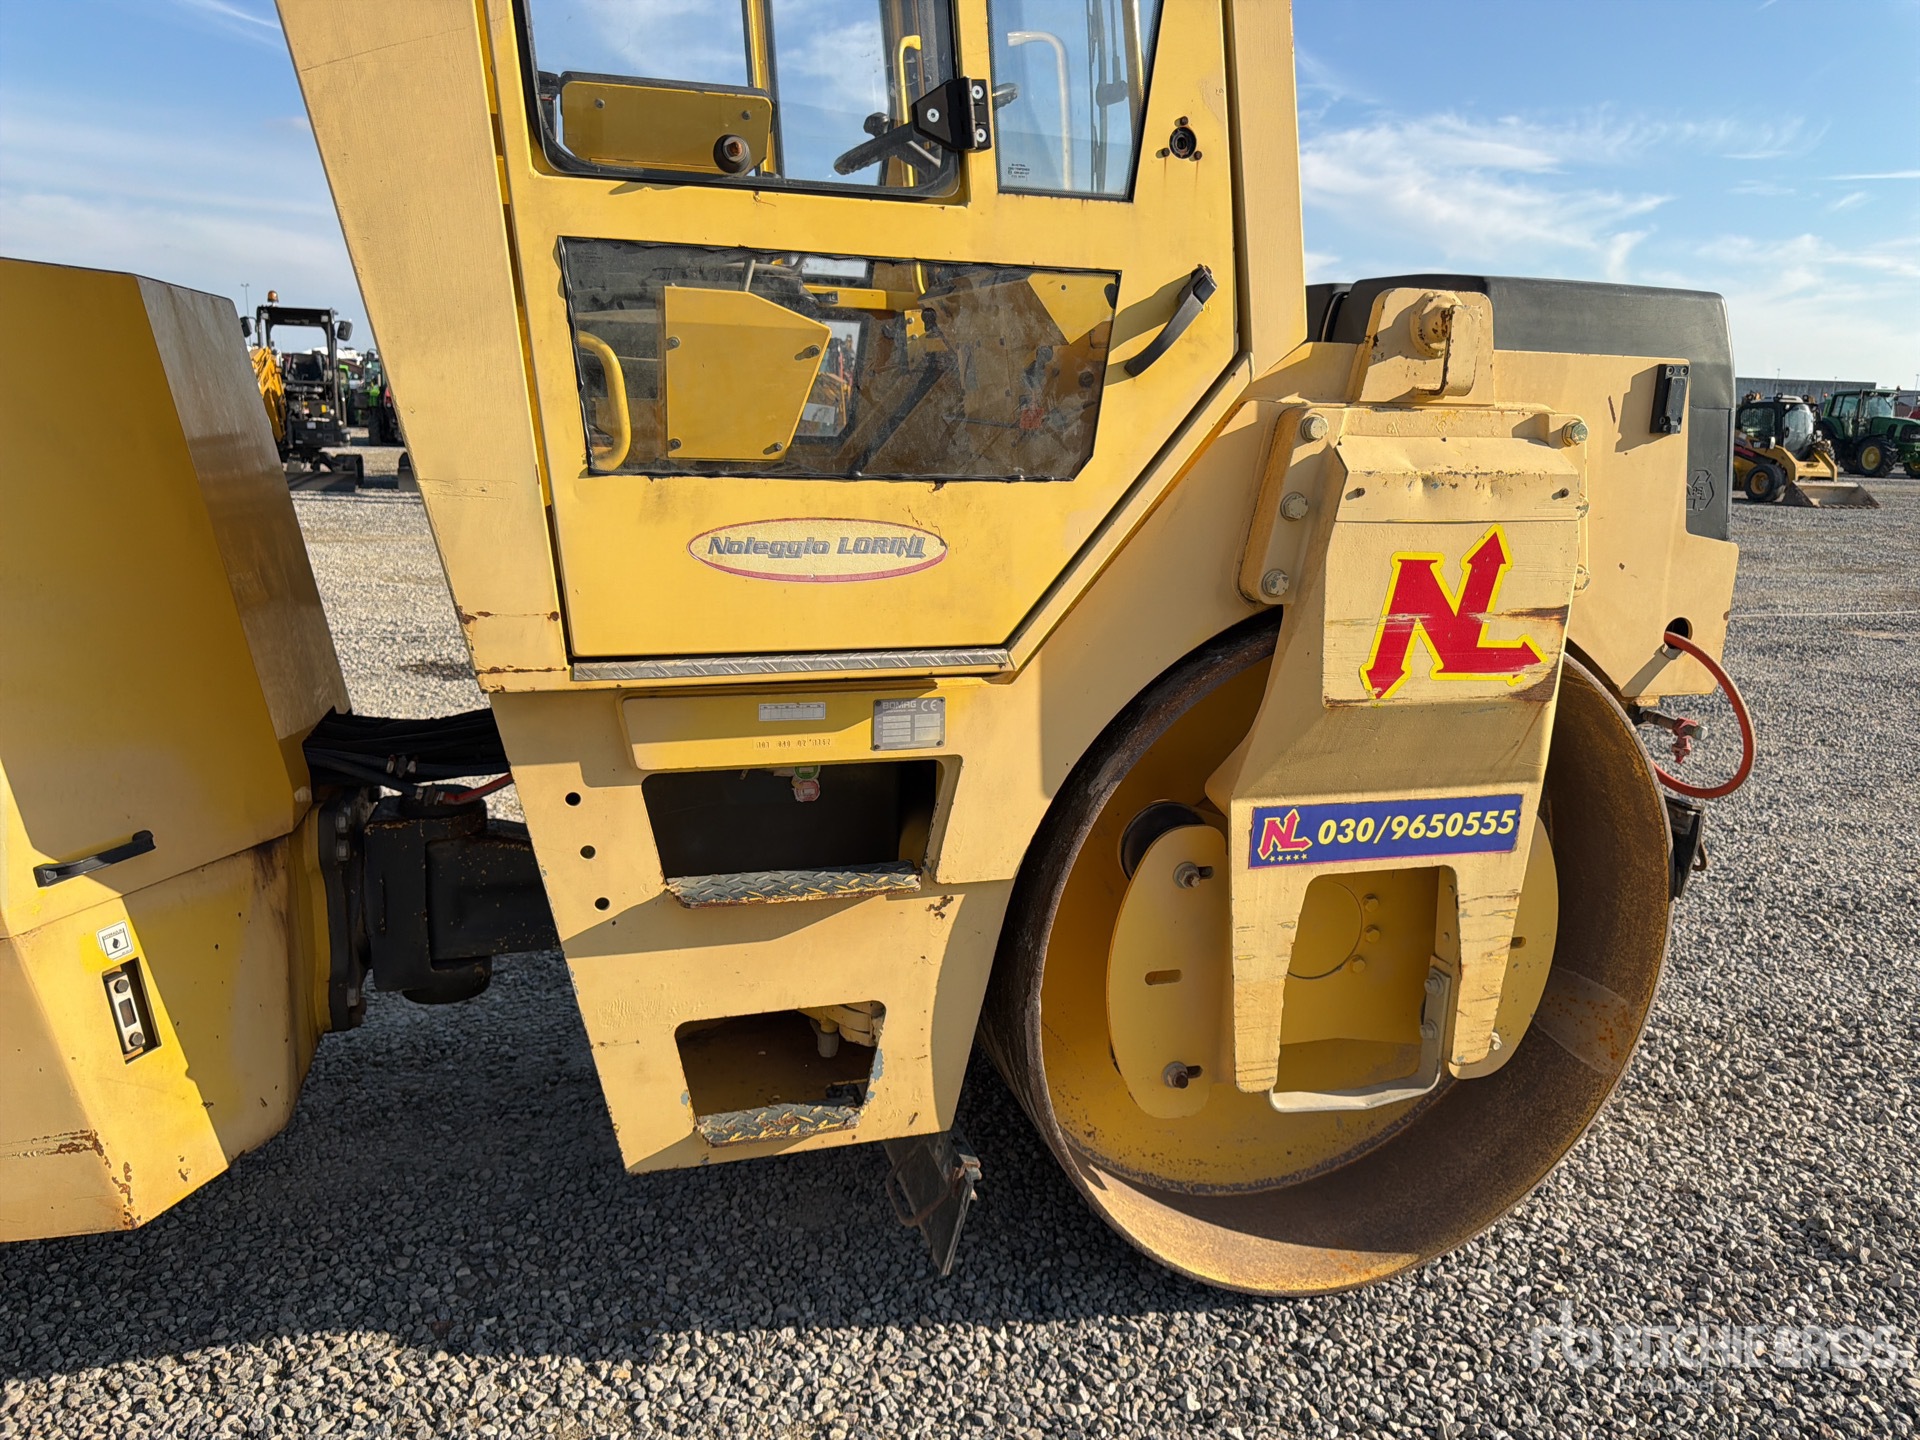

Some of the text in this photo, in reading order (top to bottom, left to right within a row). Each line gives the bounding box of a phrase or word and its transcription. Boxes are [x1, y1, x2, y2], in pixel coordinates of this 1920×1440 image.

[707, 536, 831, 559] Noleggio
[882, 700, 917, 710] BOMAG
[1317, 809, 1517, 845] 030/9650555
